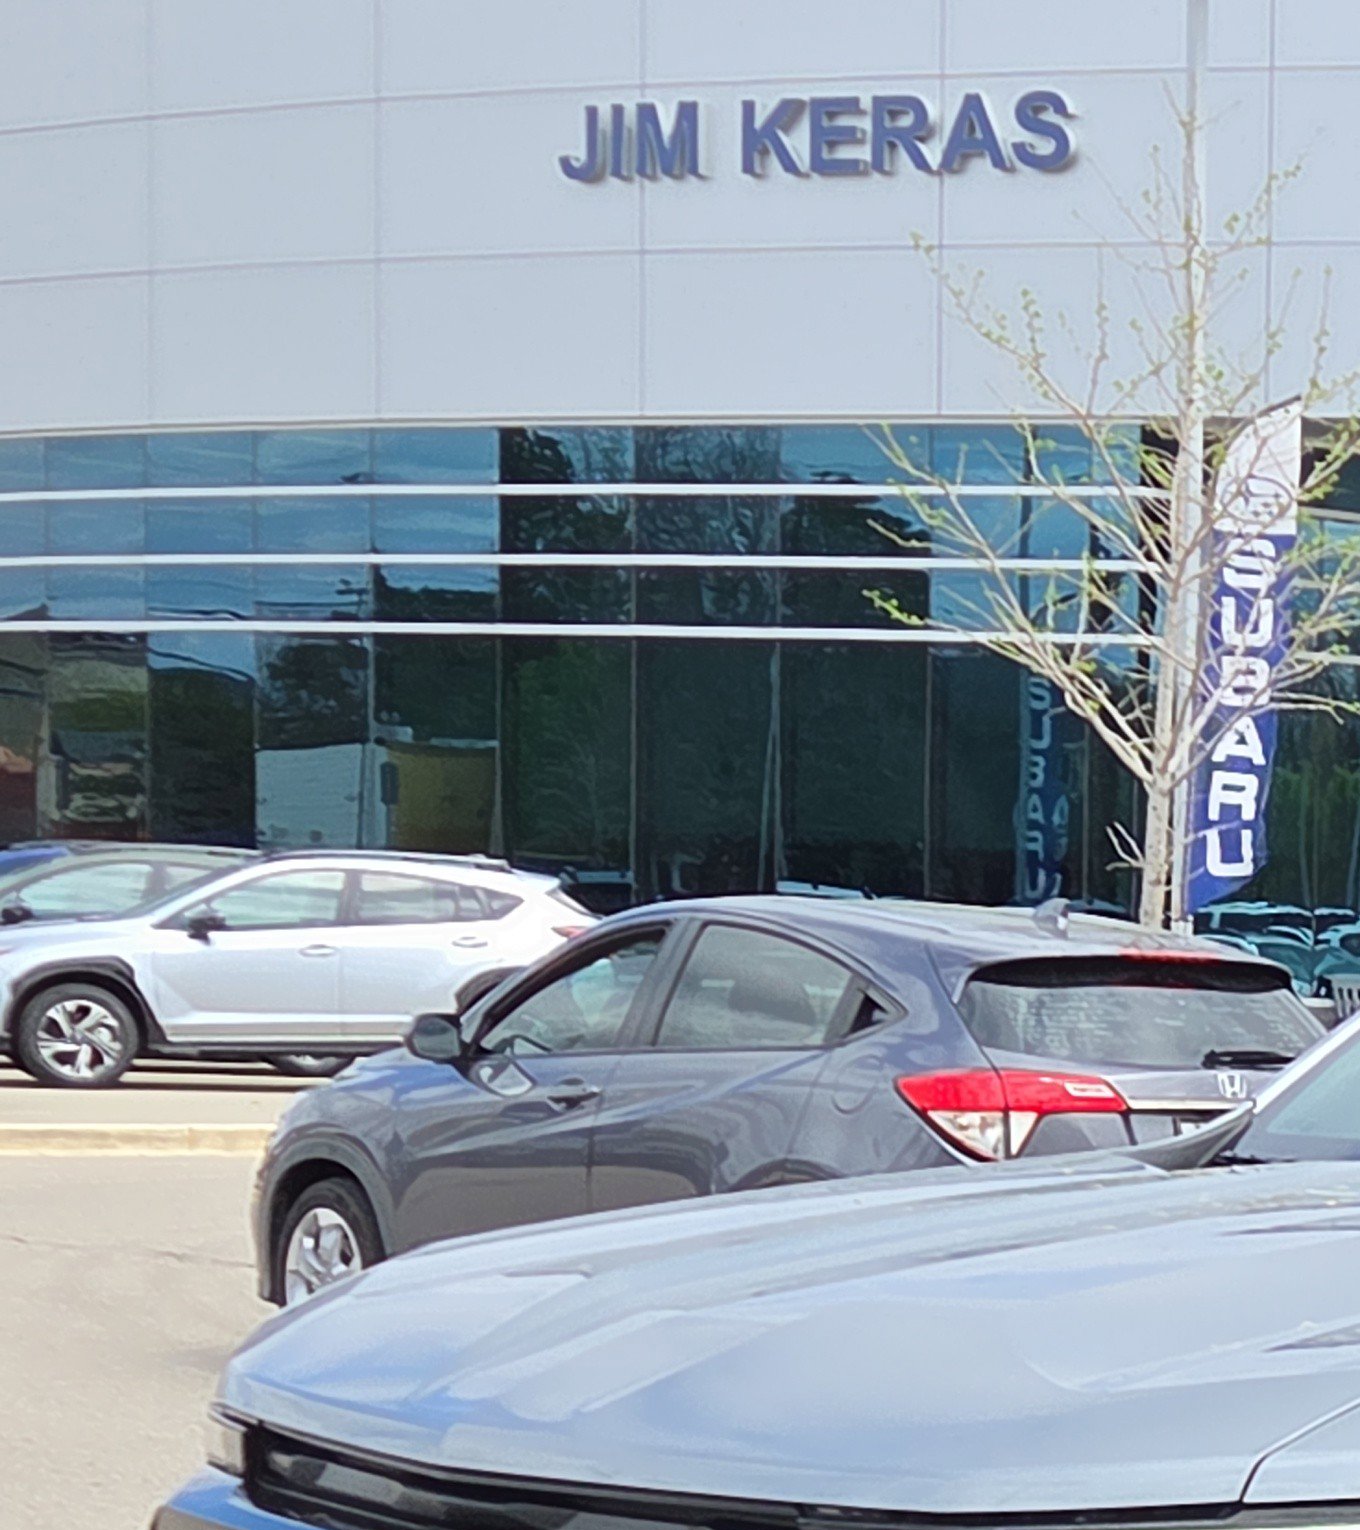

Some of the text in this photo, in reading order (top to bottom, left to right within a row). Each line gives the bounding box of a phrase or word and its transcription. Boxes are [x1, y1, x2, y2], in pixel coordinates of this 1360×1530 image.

[558, 91, 1077, 182] JIM KERAS
[1205, 537, 1278, 878] SUBARU
